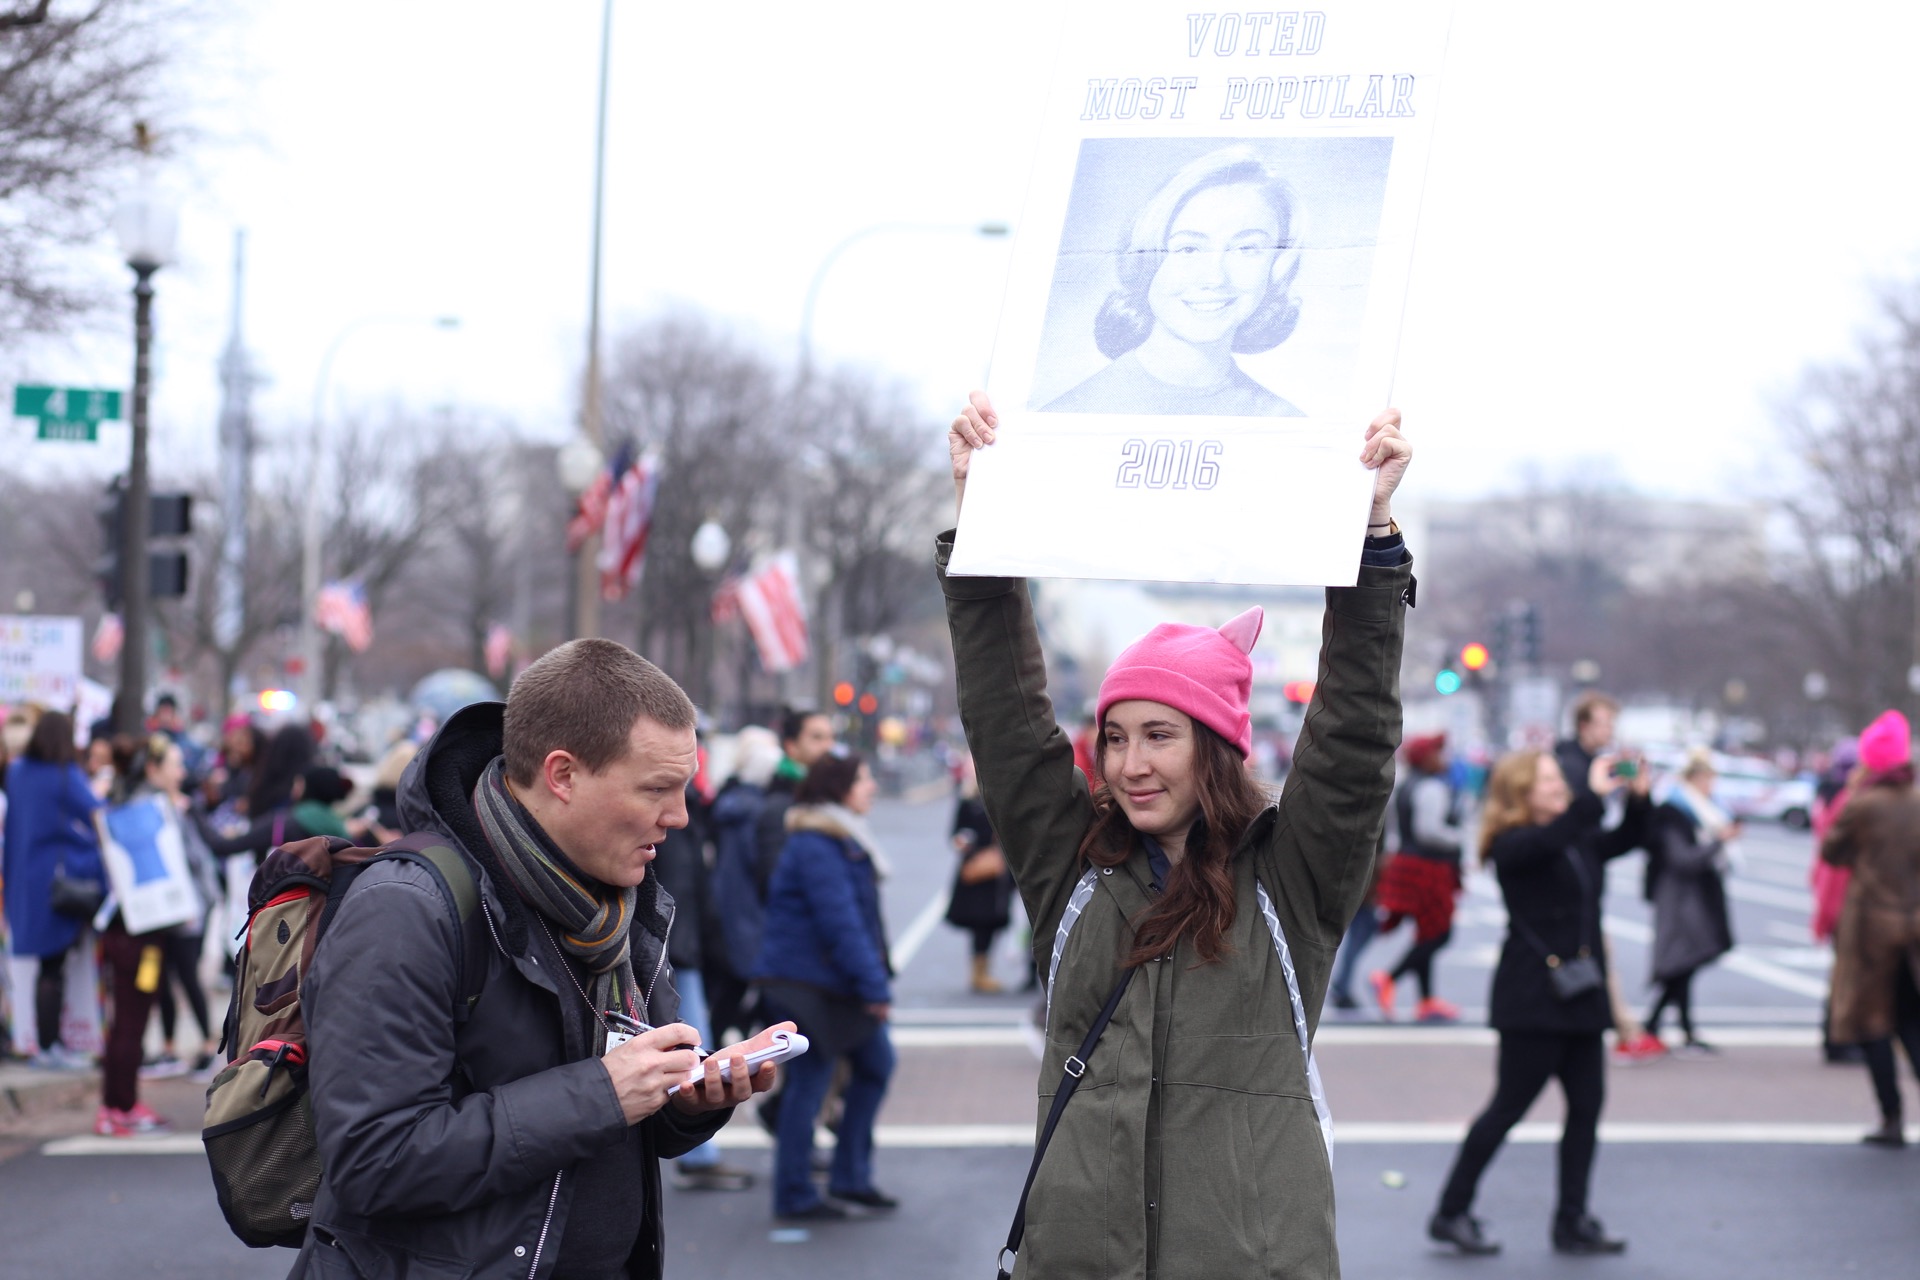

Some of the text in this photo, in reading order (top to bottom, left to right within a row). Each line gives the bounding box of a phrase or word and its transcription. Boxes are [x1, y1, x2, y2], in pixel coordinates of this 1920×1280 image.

[1187, 11, 1326, 57] VOTED
[1080, 73, 1415, 120] MOST POPULAR
[1116, 438, 1223, 490] 2016
